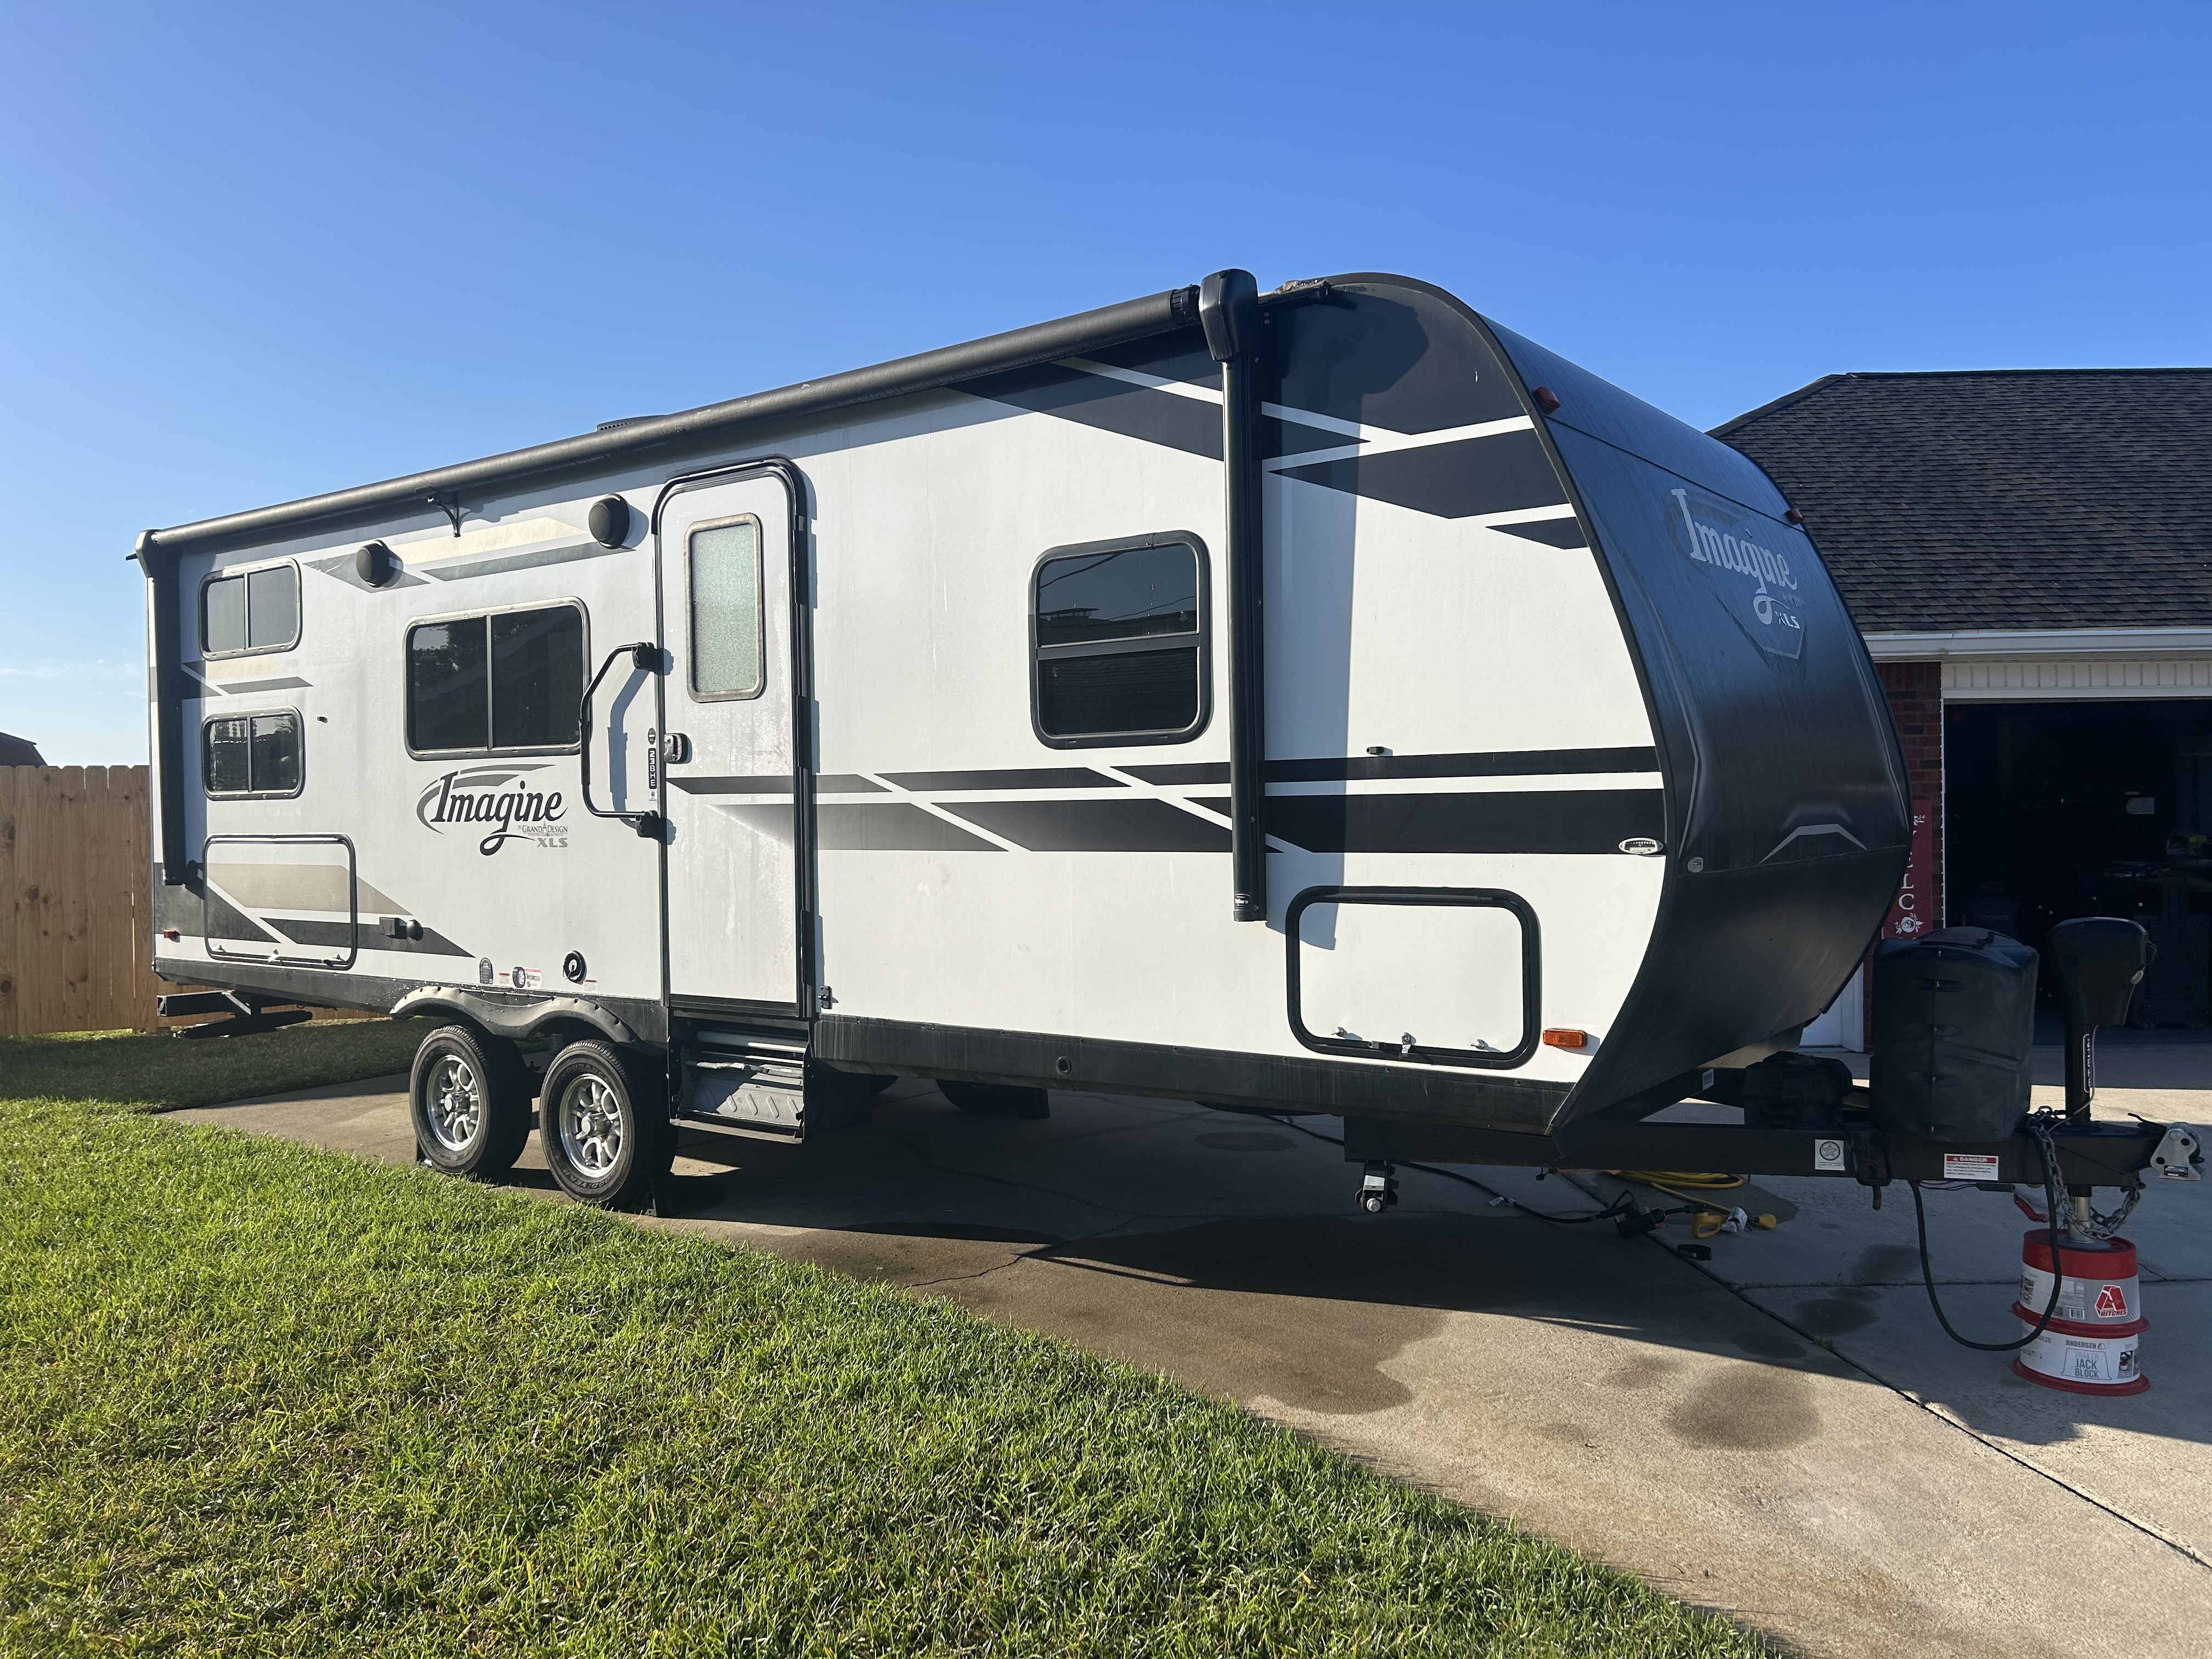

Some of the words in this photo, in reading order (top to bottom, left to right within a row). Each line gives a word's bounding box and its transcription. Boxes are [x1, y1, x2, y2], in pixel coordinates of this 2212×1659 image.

[1671, 488, 1798, 625] Imagine
[1774, 611, 1801, 629] XLS
[430, 770, 569, 856] Imagine
[522, 825, 543, 833] GRAND
[547, 825, 568, 833] DESIGN
[537, 837, 568, 848] XLS
[2065, 1339, 2097, 1350] ANDERSEN
[2075, 1351, 2099, 1361] TRAILER
[2075, 1358, 2098, 1370] JACK
[2075, 1368, 2099, 1379] BLOCK
